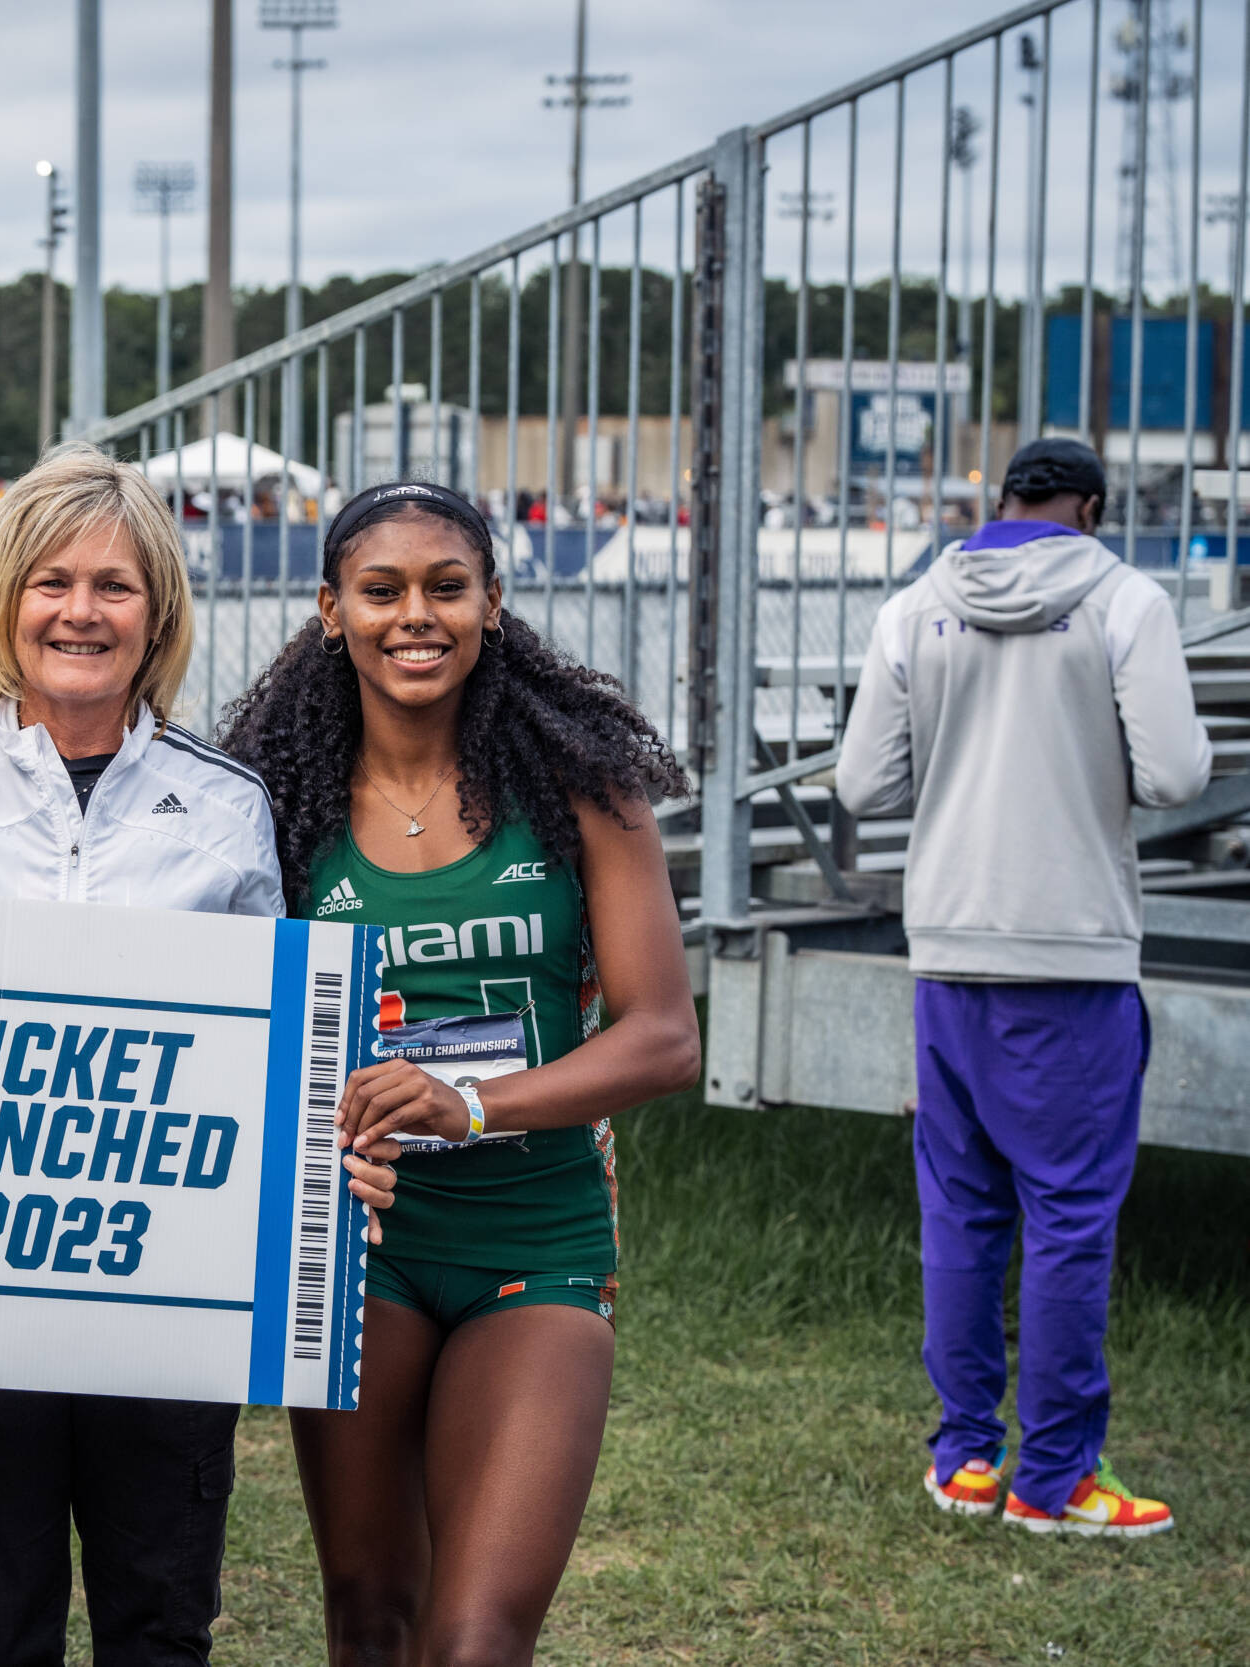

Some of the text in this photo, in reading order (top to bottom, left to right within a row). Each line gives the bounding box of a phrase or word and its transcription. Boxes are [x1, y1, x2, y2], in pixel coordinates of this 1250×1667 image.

[152, 805, 188, 814] adidas
[497, 862, 546, 879] ACC
[316, 898, 363, 917] adidas
[397, 1049, 405, 1058] &
[406, 1048, 432, 1058] FIELD
[435, 1038, 518, 1056] CHAMPIONSHIPS
